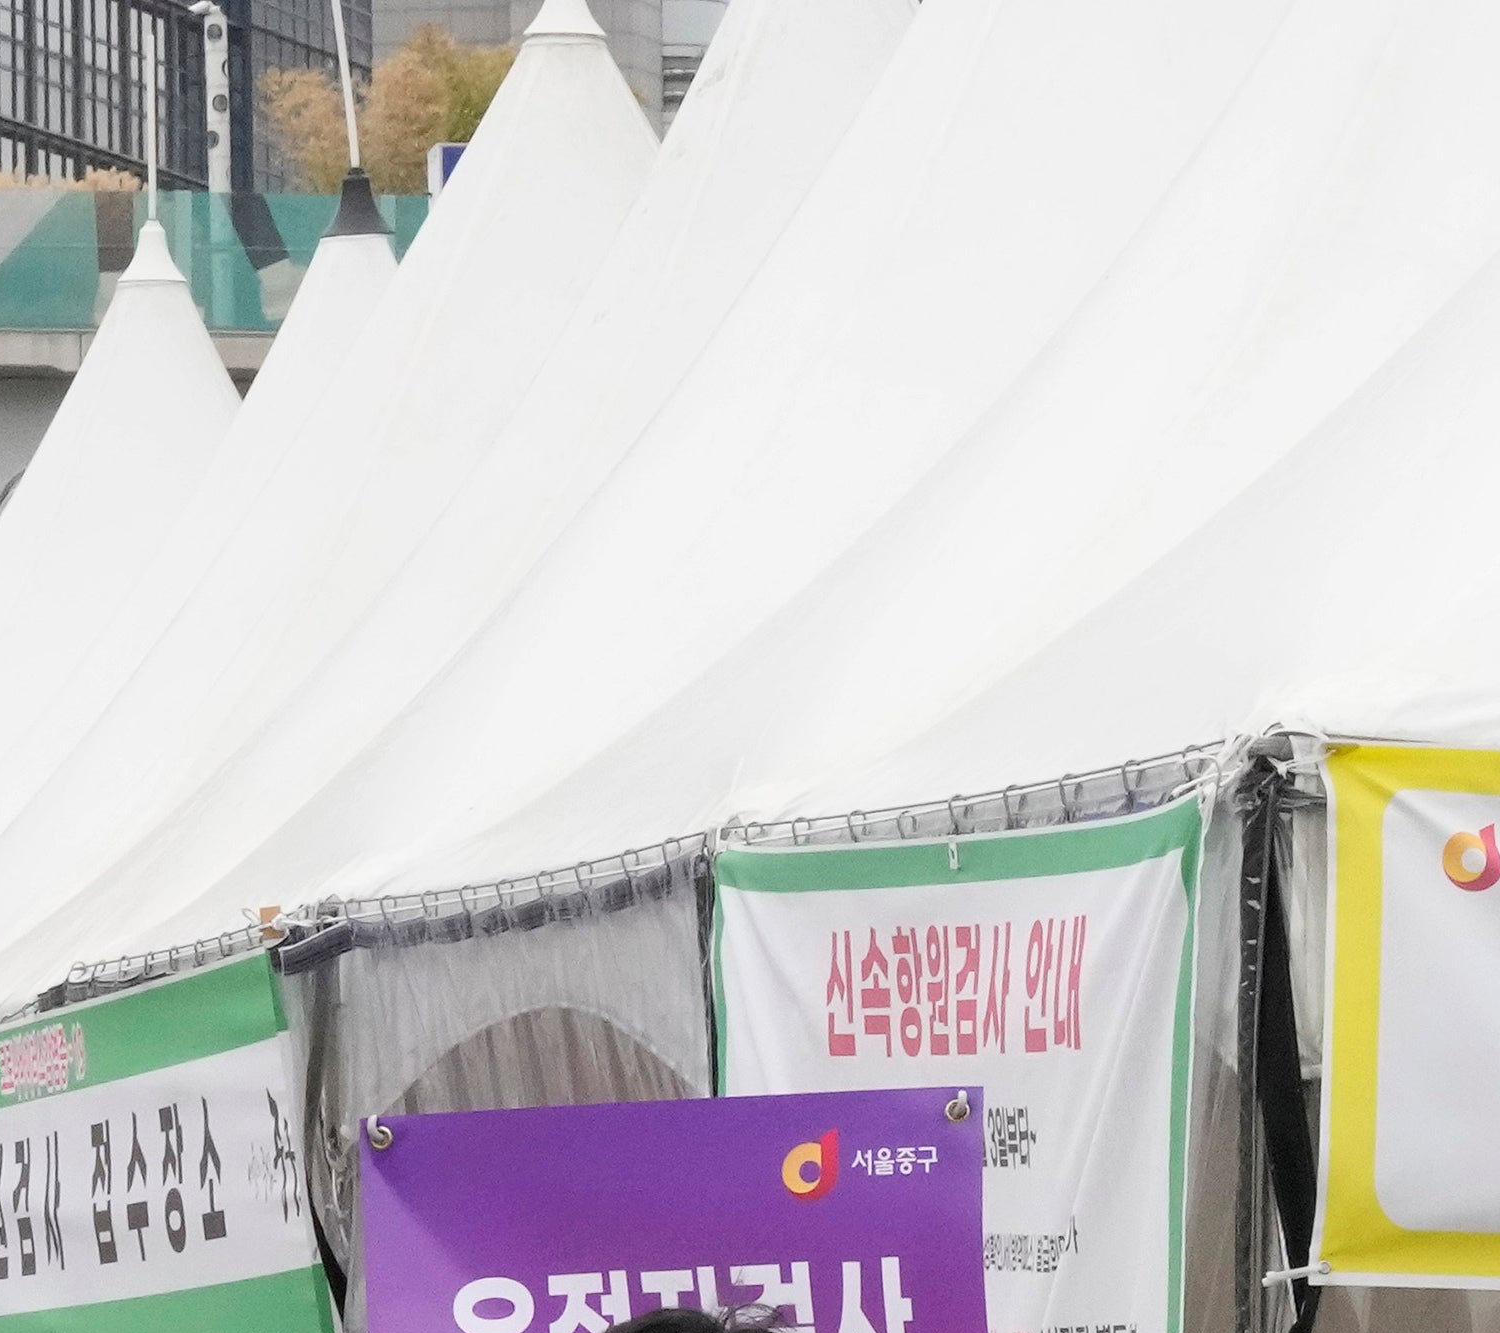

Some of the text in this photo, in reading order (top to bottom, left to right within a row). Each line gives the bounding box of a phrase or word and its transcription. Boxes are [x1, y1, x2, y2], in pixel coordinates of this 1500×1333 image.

[826, 913, 1088, 1059] 신속항원검사 안내
[90, 1096, 228, 1267] 접수장소
[850, 1146, 940, 1177] 서울중구
